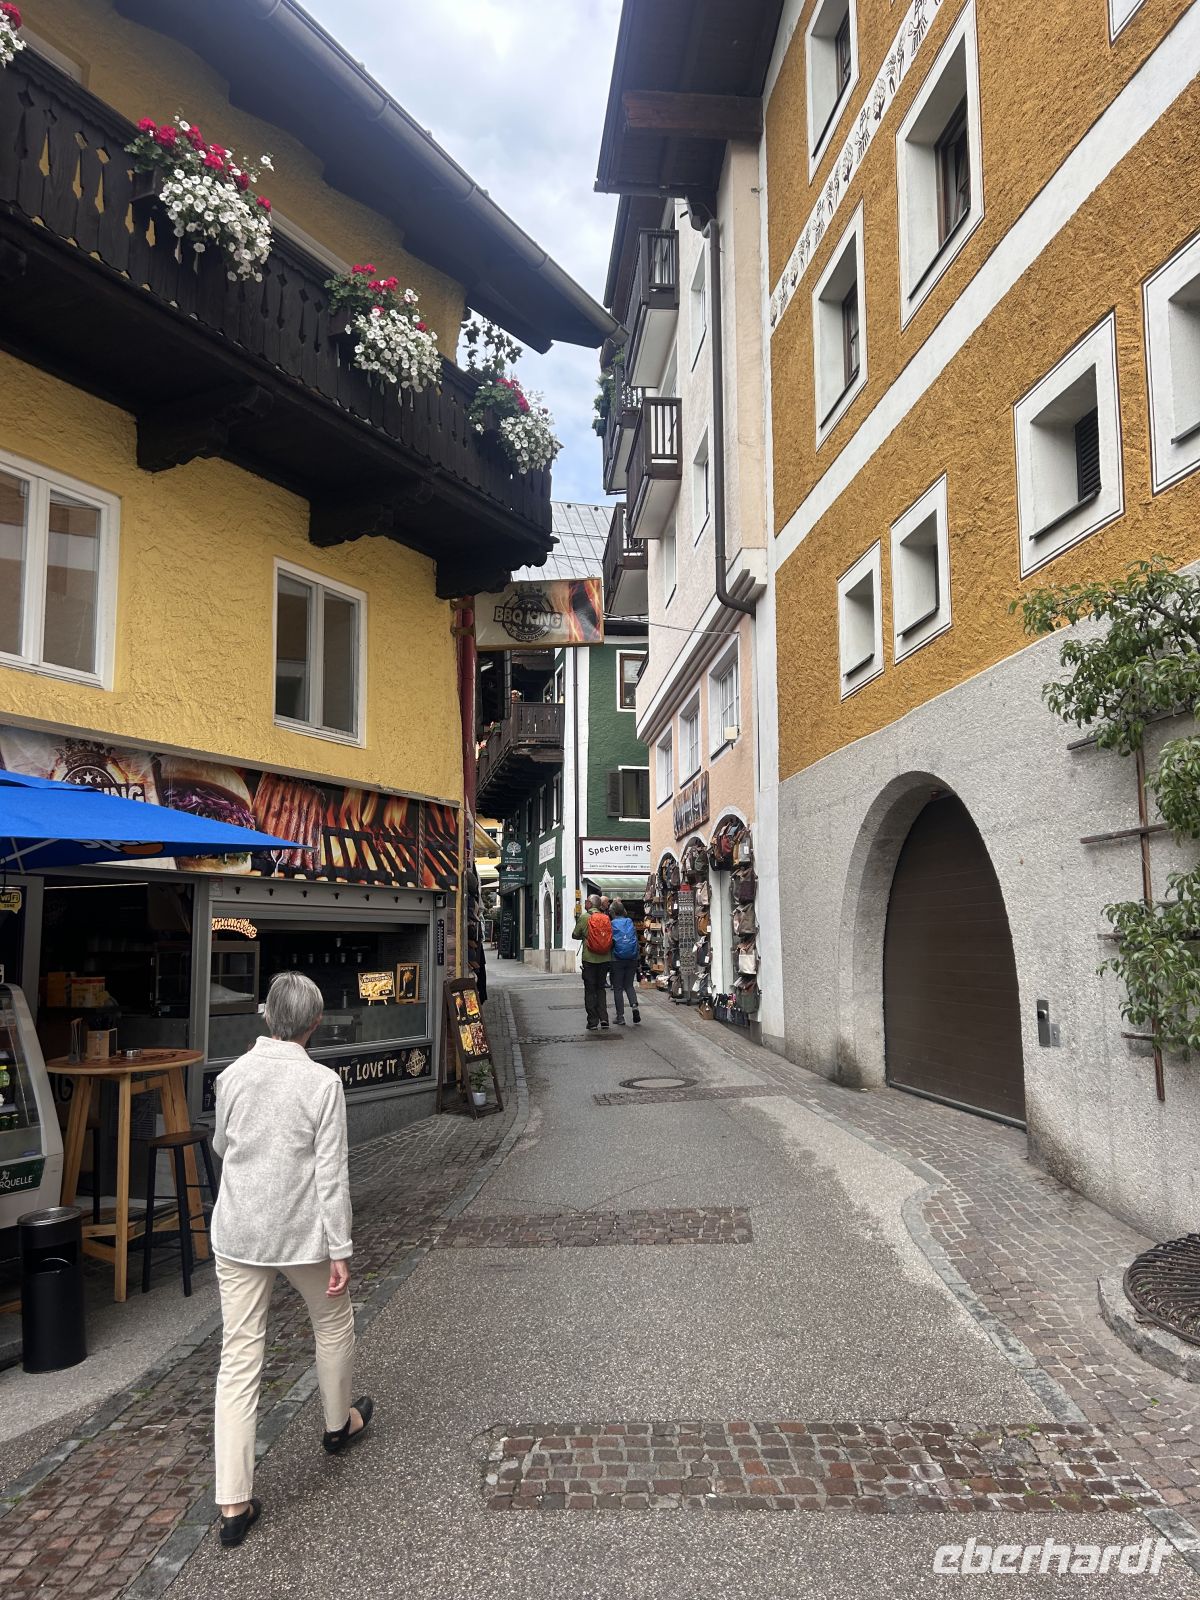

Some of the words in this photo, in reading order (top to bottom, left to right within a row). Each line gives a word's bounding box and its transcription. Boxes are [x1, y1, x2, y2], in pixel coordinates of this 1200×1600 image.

[495, 607, 523, 625] BBQ
[526, 611, 561, 628] KING
[588, 843, 631, 856] Speckerei
[633, 843, 644, 852] im
[356, 1060, 384, 1081] LOVE
[386, 1058, 398, 1075] IT
